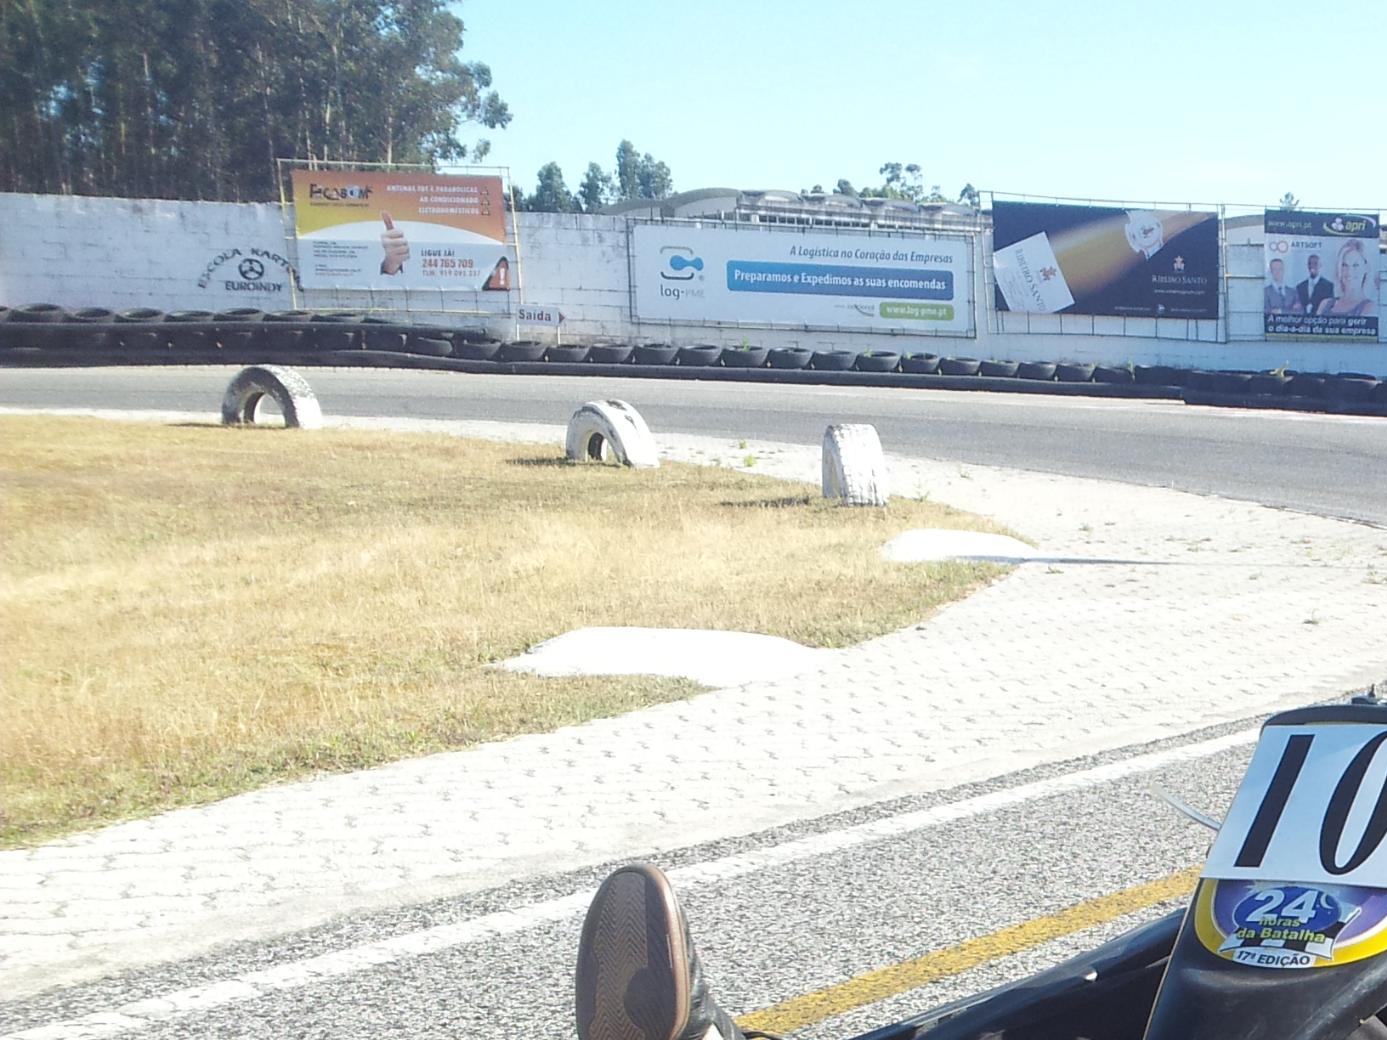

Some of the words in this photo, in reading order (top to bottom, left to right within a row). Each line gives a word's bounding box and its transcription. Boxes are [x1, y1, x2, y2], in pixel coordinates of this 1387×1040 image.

[1345, 220, 1367, 232] apri
[1291, 241, 1323, 249] ARTSOFT
[790, 245, 797, 256] A
[841, 250, 853, 259] no
[855, 249, 891, 262] Coração
[892, 251, 908, 261] das
[910, 252, 953, 264] Empresas
[225, 281, 282, 291] EUROINDY
[734, 269, 792, 283] Preparamos
[793, 274, 800, 283] e
[801, 273, 851, 286] Expedimos
[853, 277, 864, 285] as
[865, 278, 886, 287] suas
[888, 278, 946, 290] encomendas
[1246, 889, 1319, 923] 24
[1236, 928, 1256, 938] da
[1260, 928, 1327, 943] Batalha
[1257, 953, 1311, 967] EDIÇÃO
